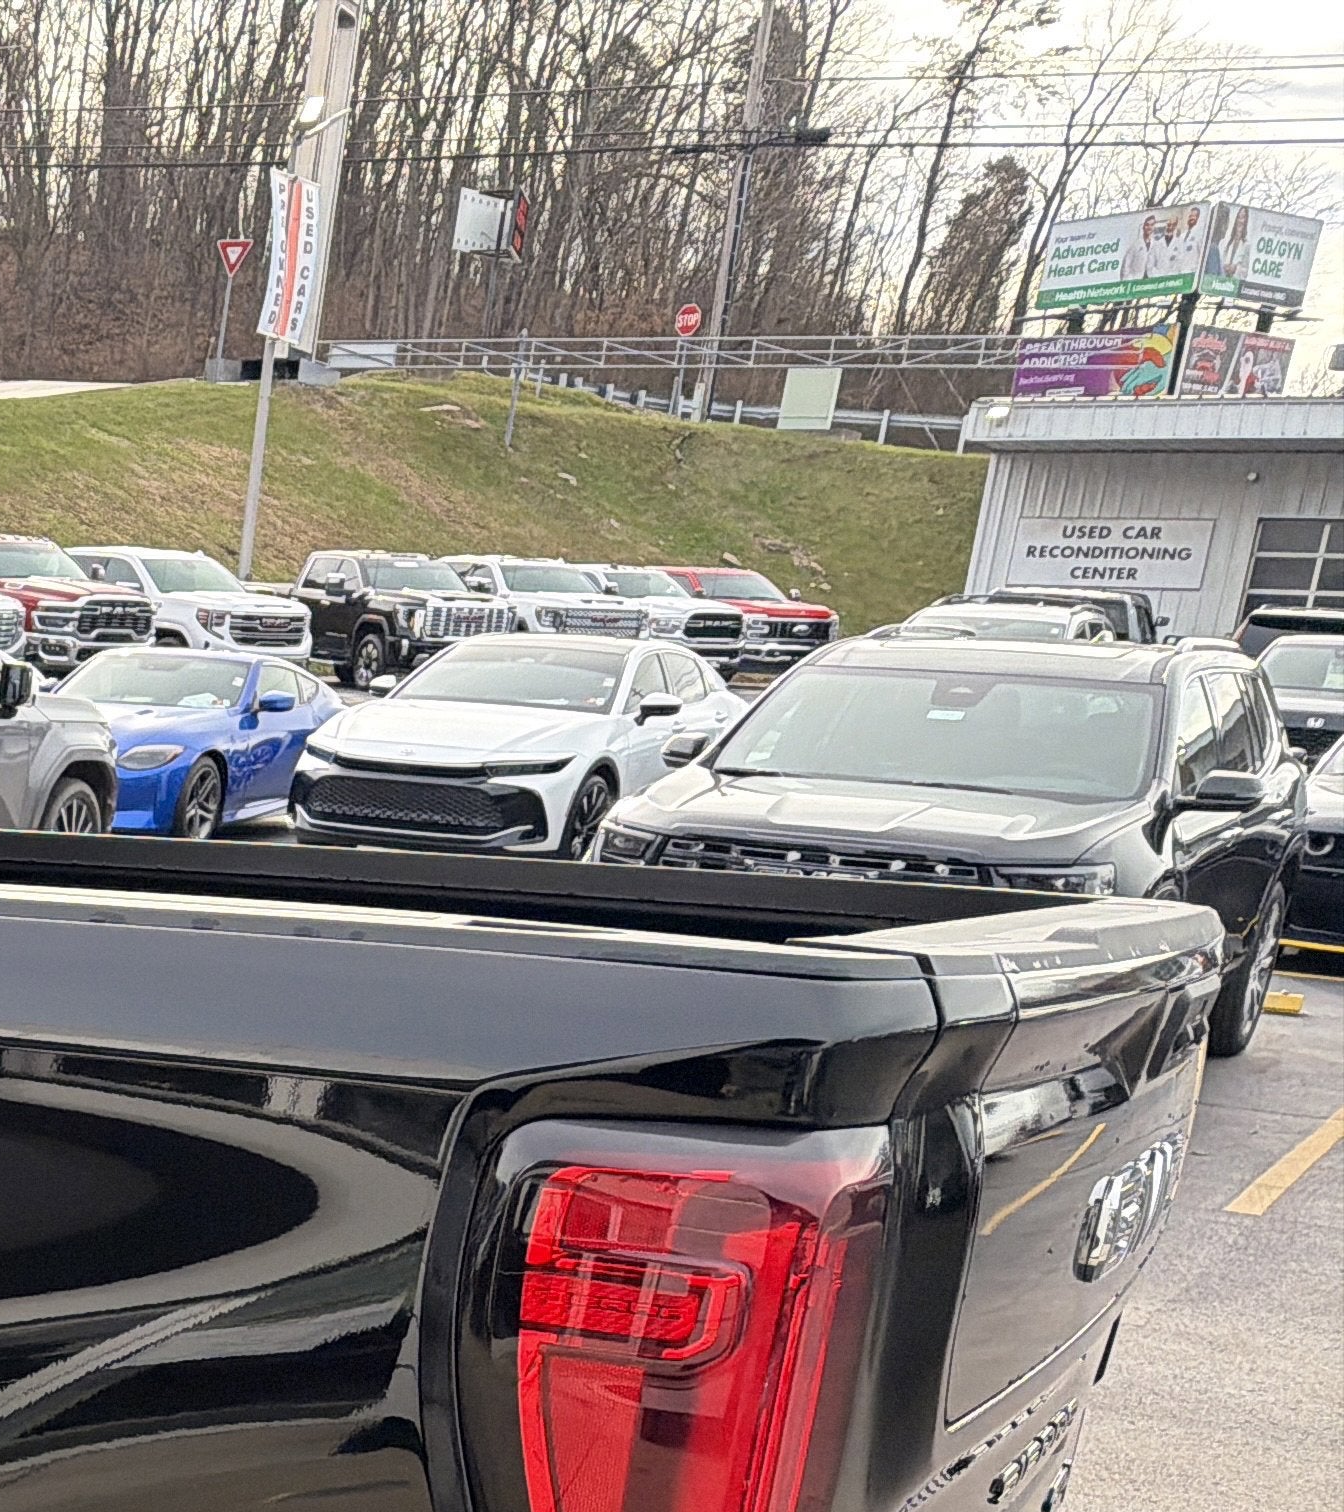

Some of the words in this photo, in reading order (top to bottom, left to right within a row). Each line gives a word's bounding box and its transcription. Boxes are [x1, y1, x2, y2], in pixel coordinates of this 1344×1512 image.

[303, 189, 314, 254] USED
[1050, 238, 1121, 261] Advanced
[1256, 236, 1304, 260] OB/GYN
[1047, 261, 1085, 279] Heart
[1087, 258, 1120, 275] Care
[1252, 258, 1285, 278] CARE
[290, 267, 310, 331] CARS
[678, 313, 699, 328] STOP
[1023, 353, 1088, 367] ADDICTION
[1062, 525, 1112, 540] USED
[1122, 526, 1162, 540] CAR
[1026, 545, 1192, 561] RECONDITIONING
[1070, 566, 1138, 581] CENTER
